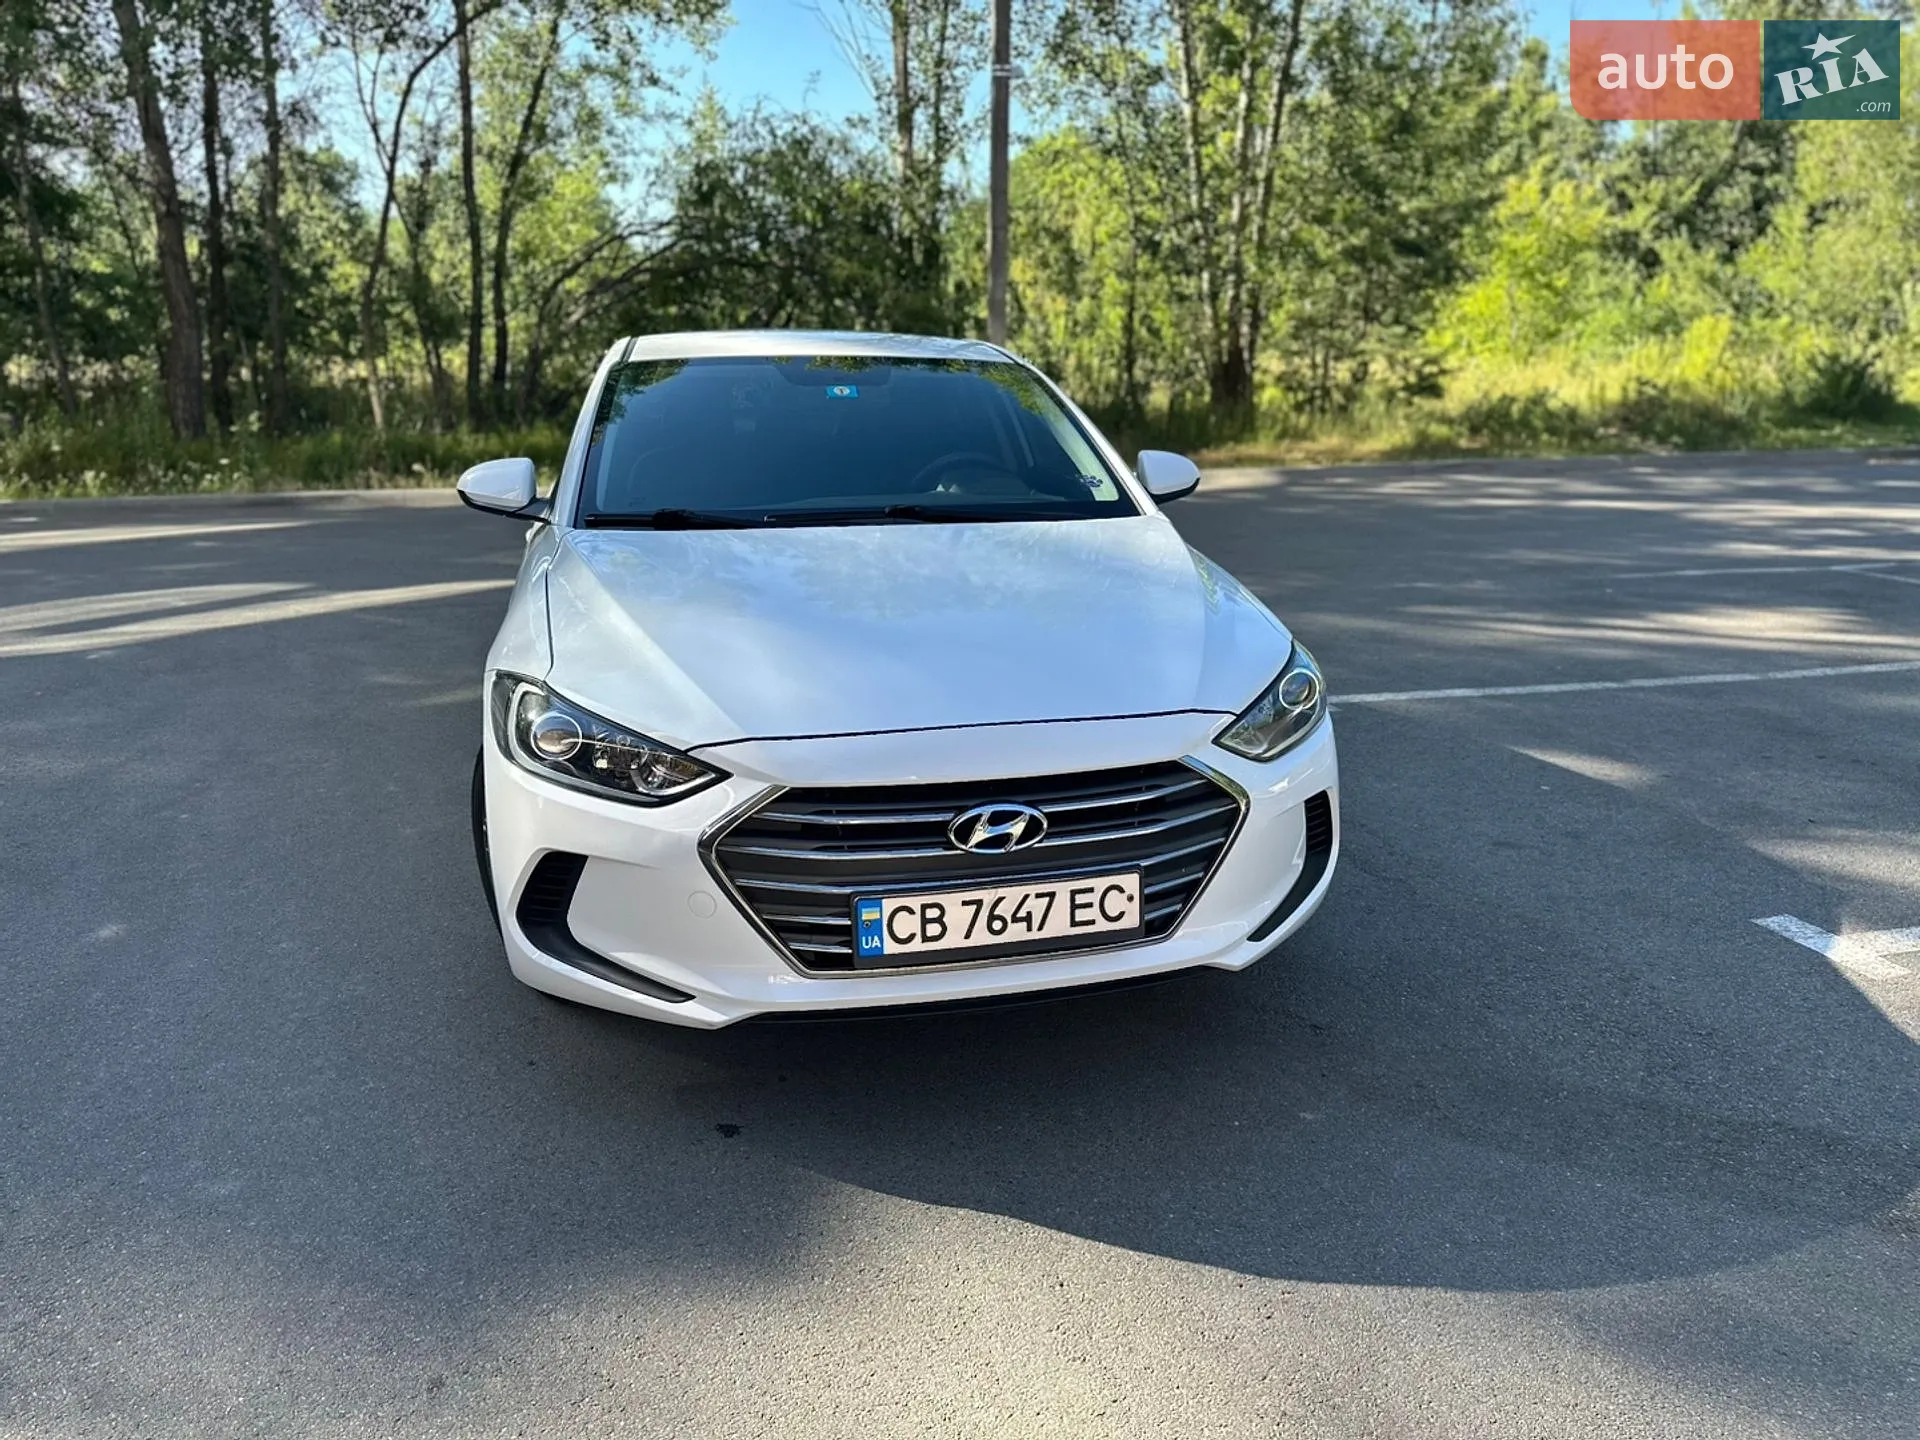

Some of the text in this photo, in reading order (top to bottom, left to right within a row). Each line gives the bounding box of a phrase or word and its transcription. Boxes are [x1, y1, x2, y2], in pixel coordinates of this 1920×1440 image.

[886, 883, 1127, 945] CB 7647 EC
[861, 935, 881, 949] UA
